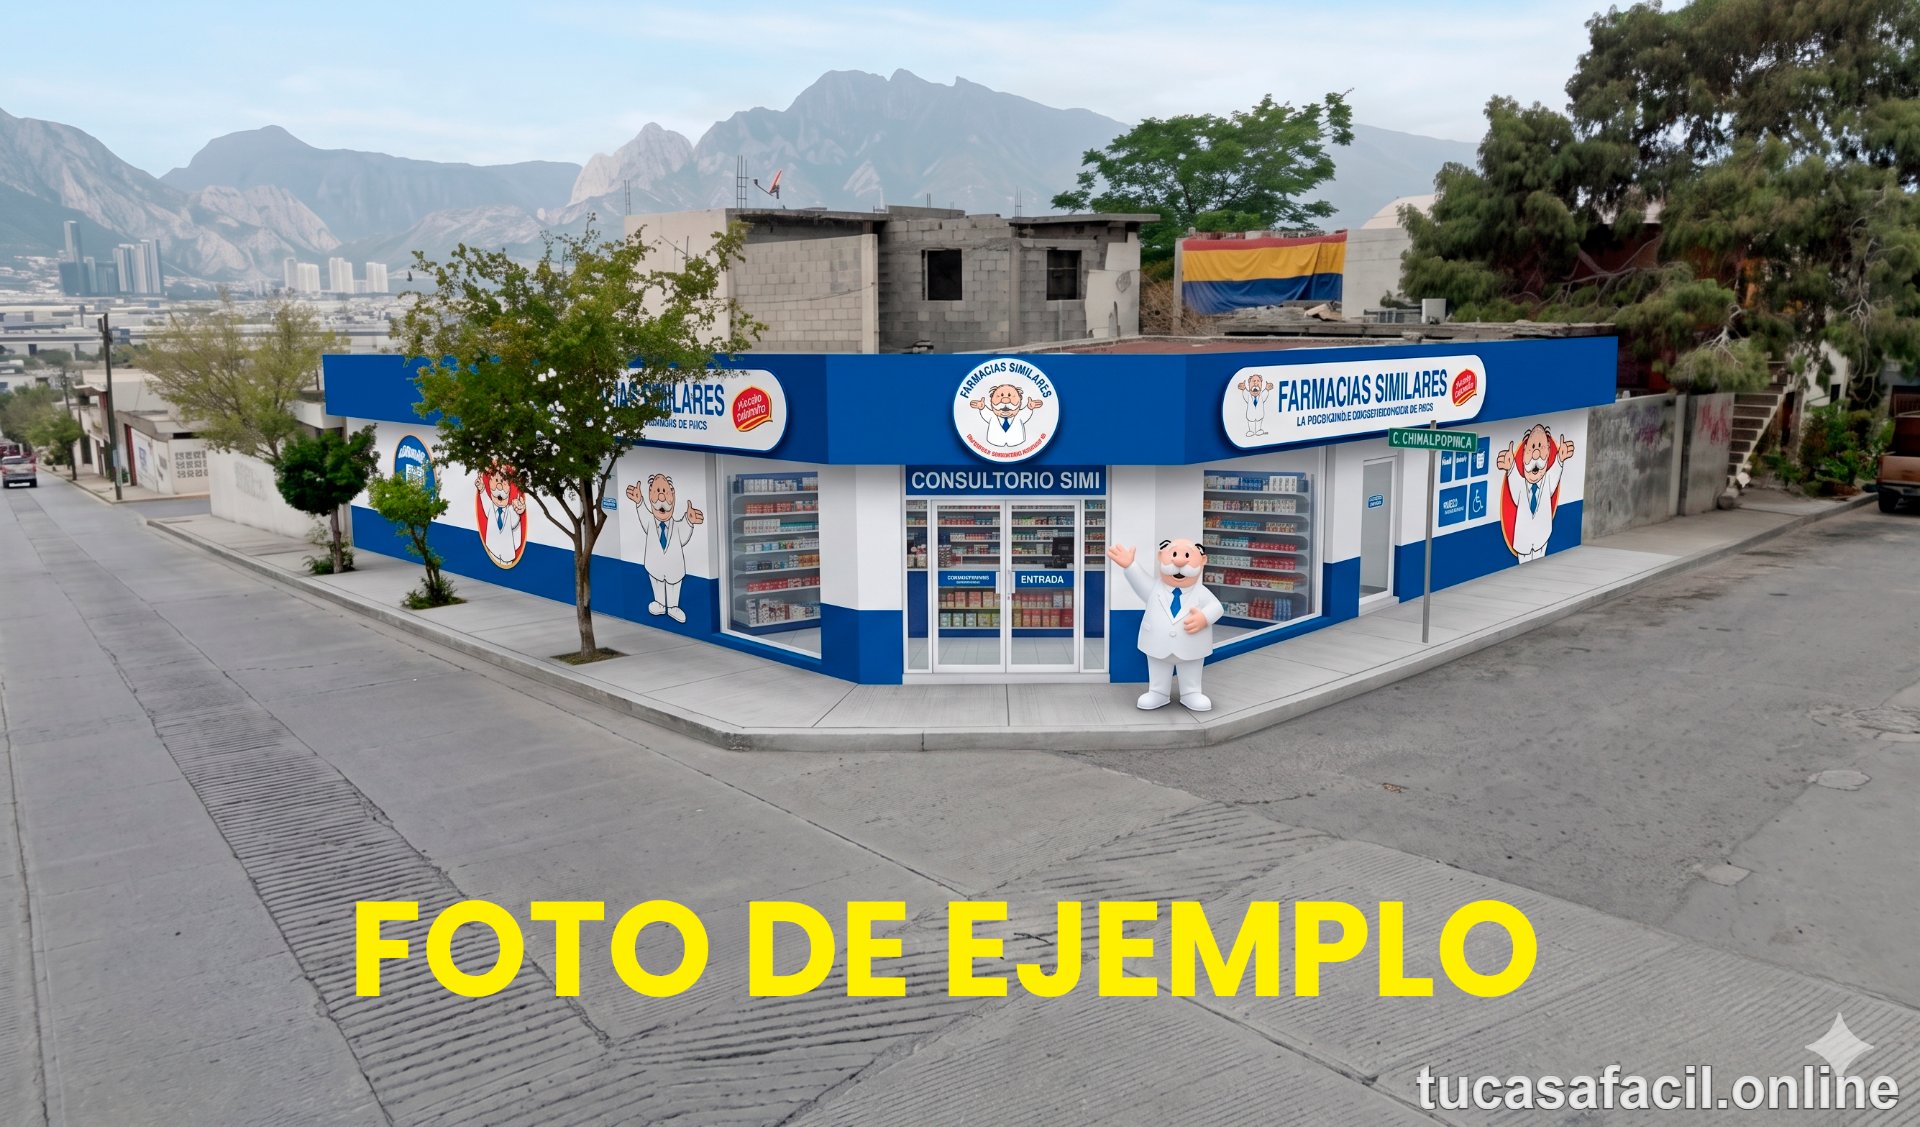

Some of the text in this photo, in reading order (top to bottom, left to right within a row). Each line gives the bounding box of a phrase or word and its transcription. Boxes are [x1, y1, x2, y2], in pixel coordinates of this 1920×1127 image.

[960, 362, 1052, 399] FARMACIAS SIMILARES
[1278, 374, 1371, 413] FARMACIAS
[1375, 369, 1448, 404] SIMILARES
[1296, 416, 1306, 427] LA
[1392, 431, 1400, 445] C.
[911, 471, 1100, 489] CONSULTORIO SIMI
[1021, 575, 1064, 584] ENTRADA
